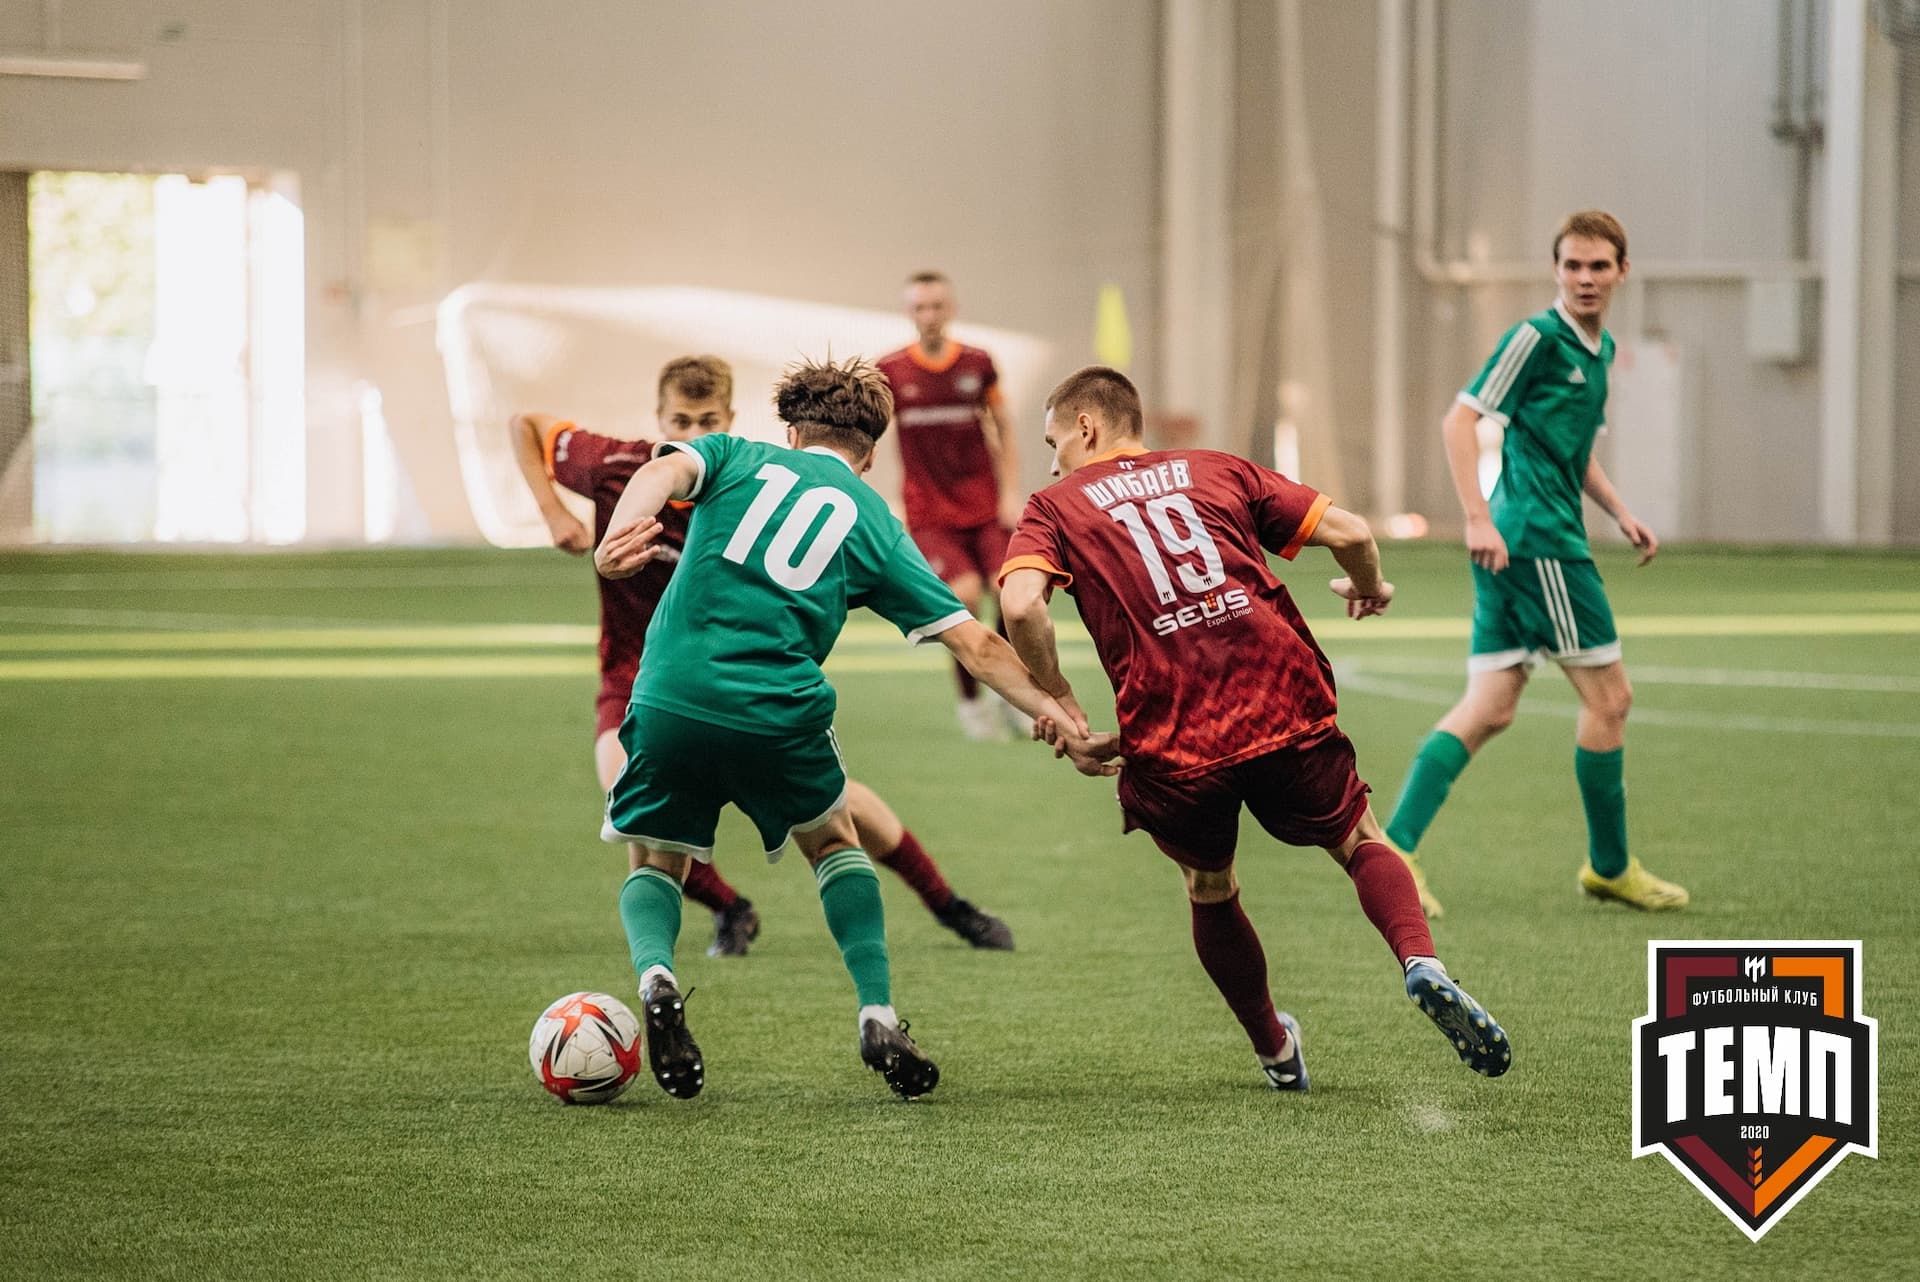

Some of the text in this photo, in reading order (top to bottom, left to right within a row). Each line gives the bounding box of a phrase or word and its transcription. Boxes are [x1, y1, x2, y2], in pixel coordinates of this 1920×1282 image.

[1083, 461, 1191, 506] ШИБАЕВ
[722, 463, 858, 591] 10
[1107, 493, 1227, 605] 19
[1152, 589, 1250, 636] SEUS
[1206, 605, 1254, 628] Export Union
